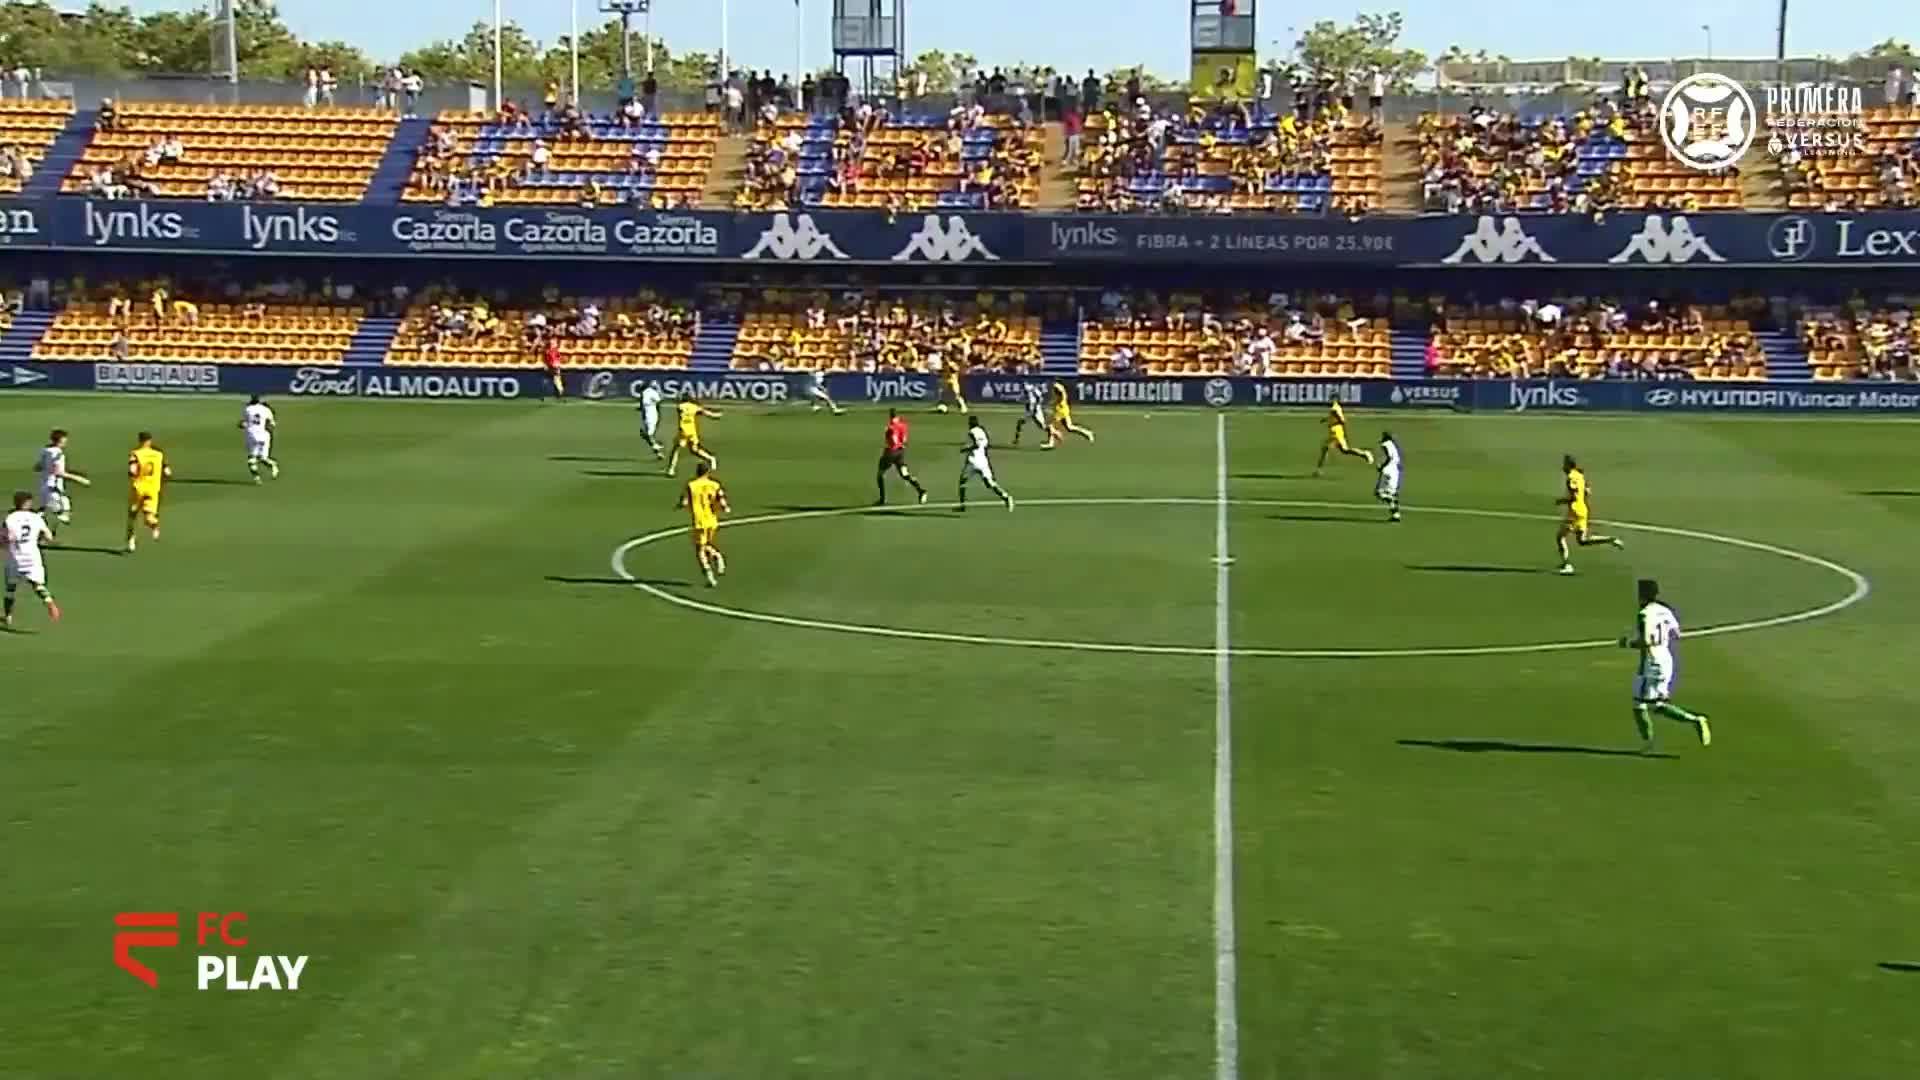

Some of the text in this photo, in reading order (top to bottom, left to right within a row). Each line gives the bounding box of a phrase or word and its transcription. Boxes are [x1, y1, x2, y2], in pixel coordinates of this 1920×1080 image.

[85, 202, 183, 245] lynks
[243, 206, 338, 249] lynks
[392, 216, 496, 241] Cazorla
[504, 218, 606, 242] Cazorla
[615, 220, 718, 244] Cazorla
[1051, 222, 1117, 250] lynks
[1210, 235, 1219, 249] 2
[1294, 236, 1329, 250] POR
[97, 365, 218, 385] BAUHAUS
[289, 367, 520, 397] Ford ALMOAUTO
[630, 379, 787, 401] CASAMAYOR
[865, 376, 927, 402] lynks
[1404, 386, 1460, 398] VERSUS
[1510, 381, 1577, 412] lynks
[1680, 390, 1919, 408] HYUNDAI Yuncar Motor
[20, 525, 31, 544] 2
